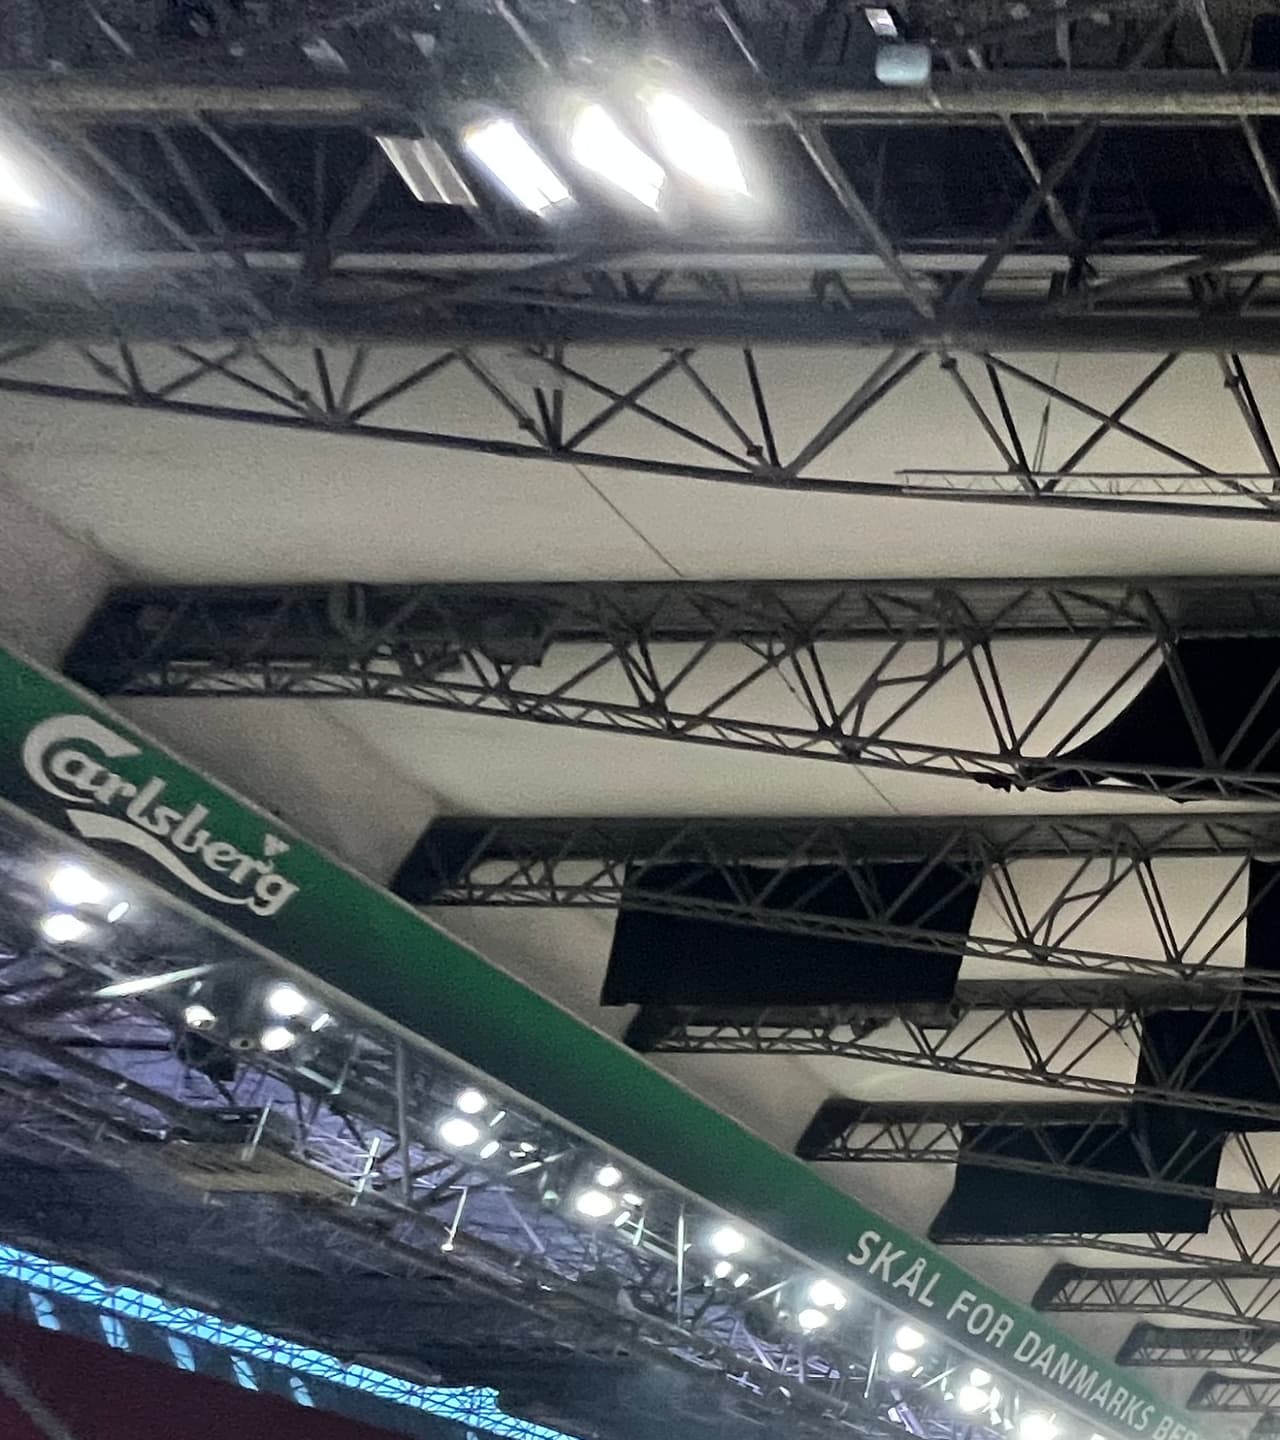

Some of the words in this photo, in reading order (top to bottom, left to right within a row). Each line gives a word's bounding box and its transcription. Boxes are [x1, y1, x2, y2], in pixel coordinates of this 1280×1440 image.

[22, 714, 299, 917] Carlsberg
[847, 1230, 942, 1308] SKÅL
[946, 1290, 1014, 1350] FOR
[1013, 1330, 1155, 1432] DANMARKS
